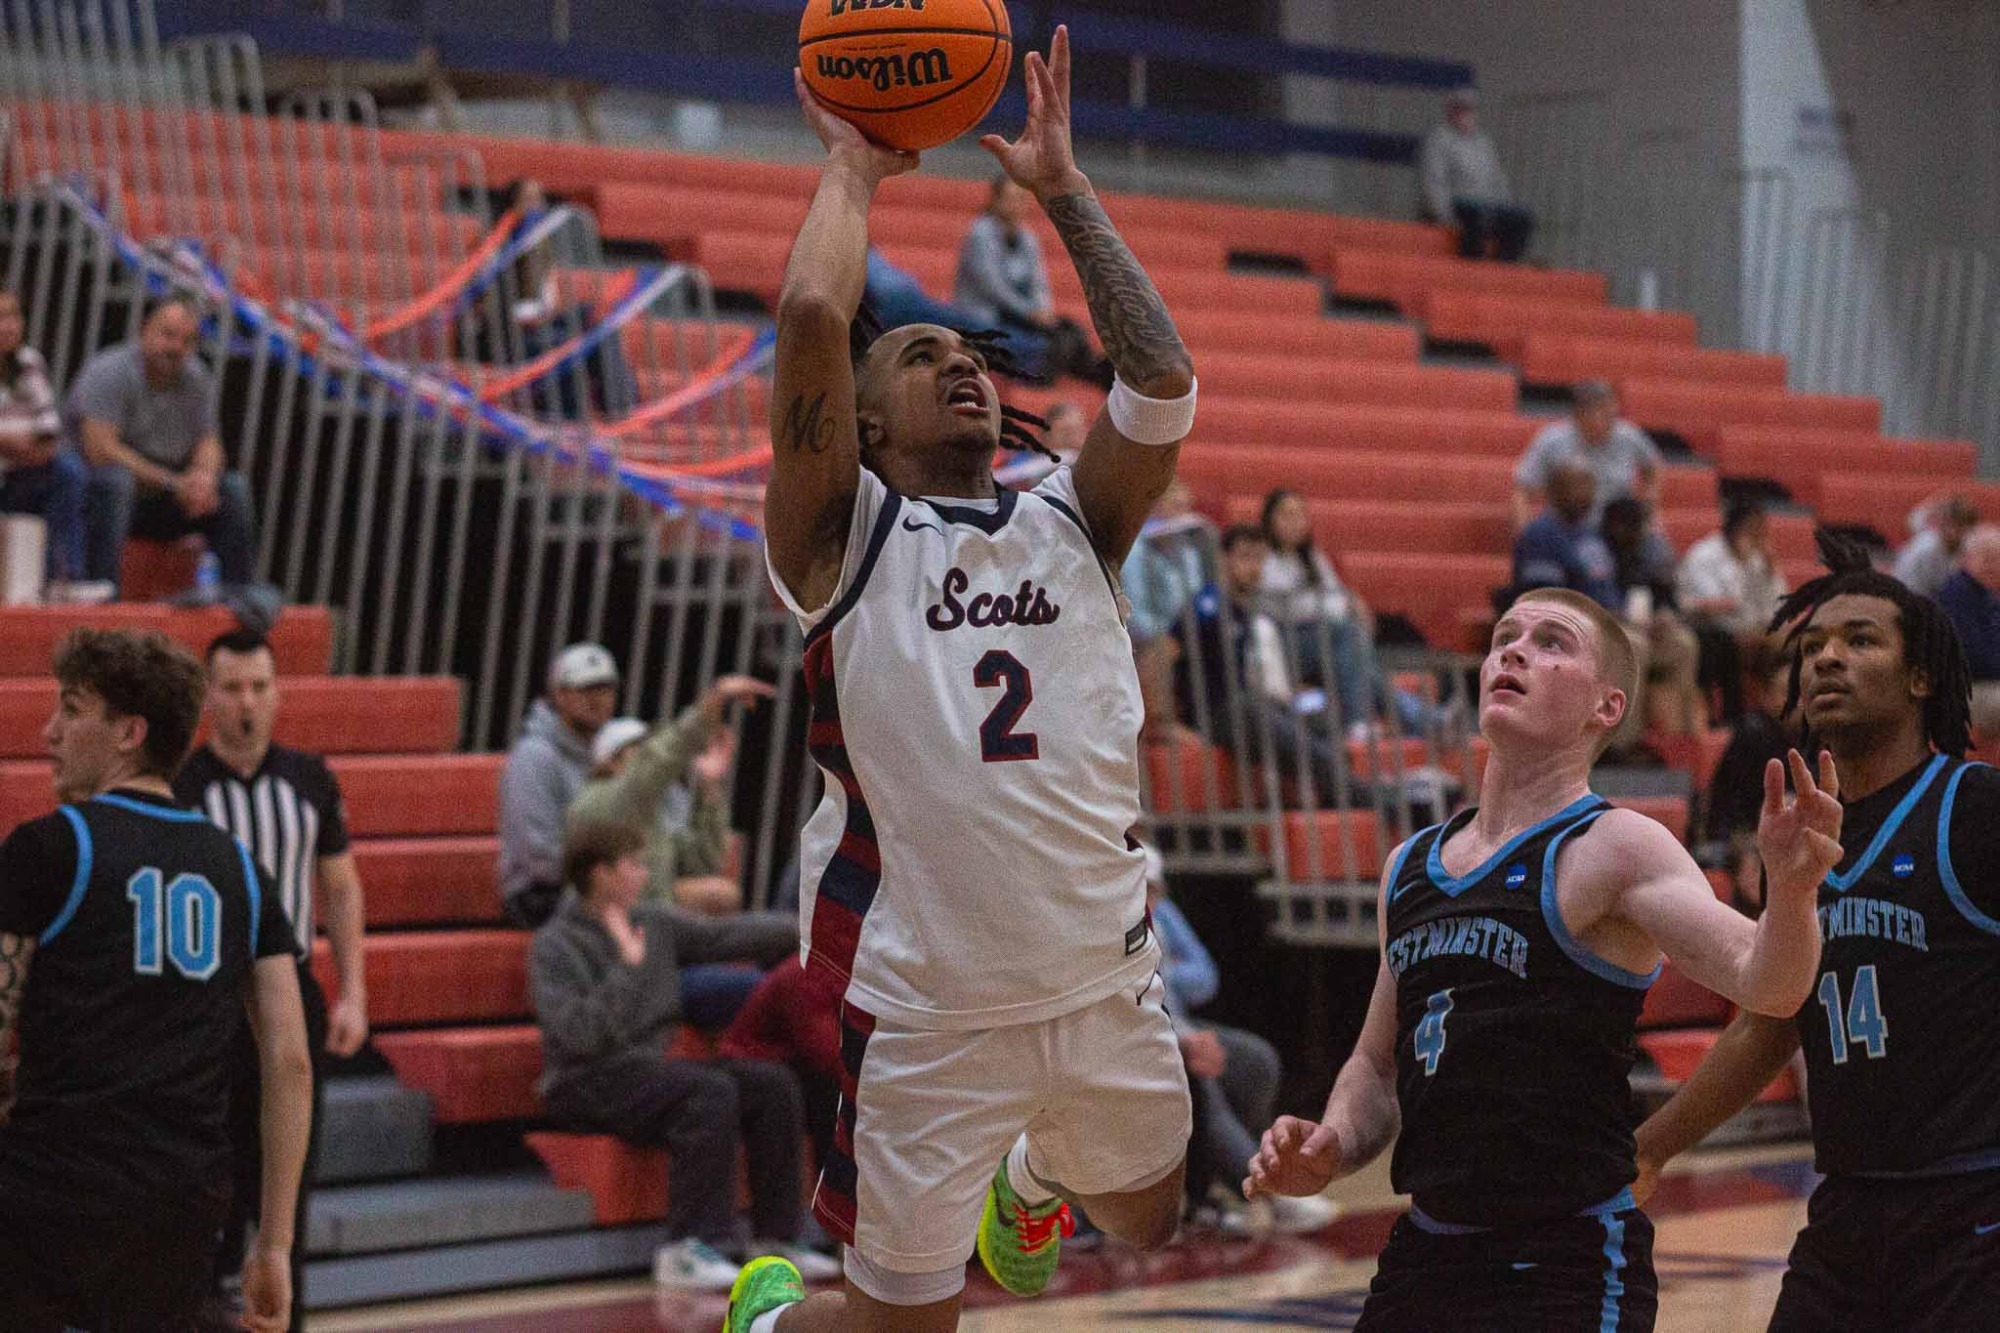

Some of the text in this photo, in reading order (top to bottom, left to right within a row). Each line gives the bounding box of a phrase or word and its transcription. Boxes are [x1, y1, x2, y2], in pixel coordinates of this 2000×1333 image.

[816, 48, 953, 91] Wilson
[926, 567, 1060, 631] Scots
[973, 649, 1039, 762] 2
[127, 866, 222, 981] 10
[1386, 916, 1529, 980] ESTMINSTER
[1415, 987, 1455, 1077] 4
[1818, 964, 1889, 1064] 14
